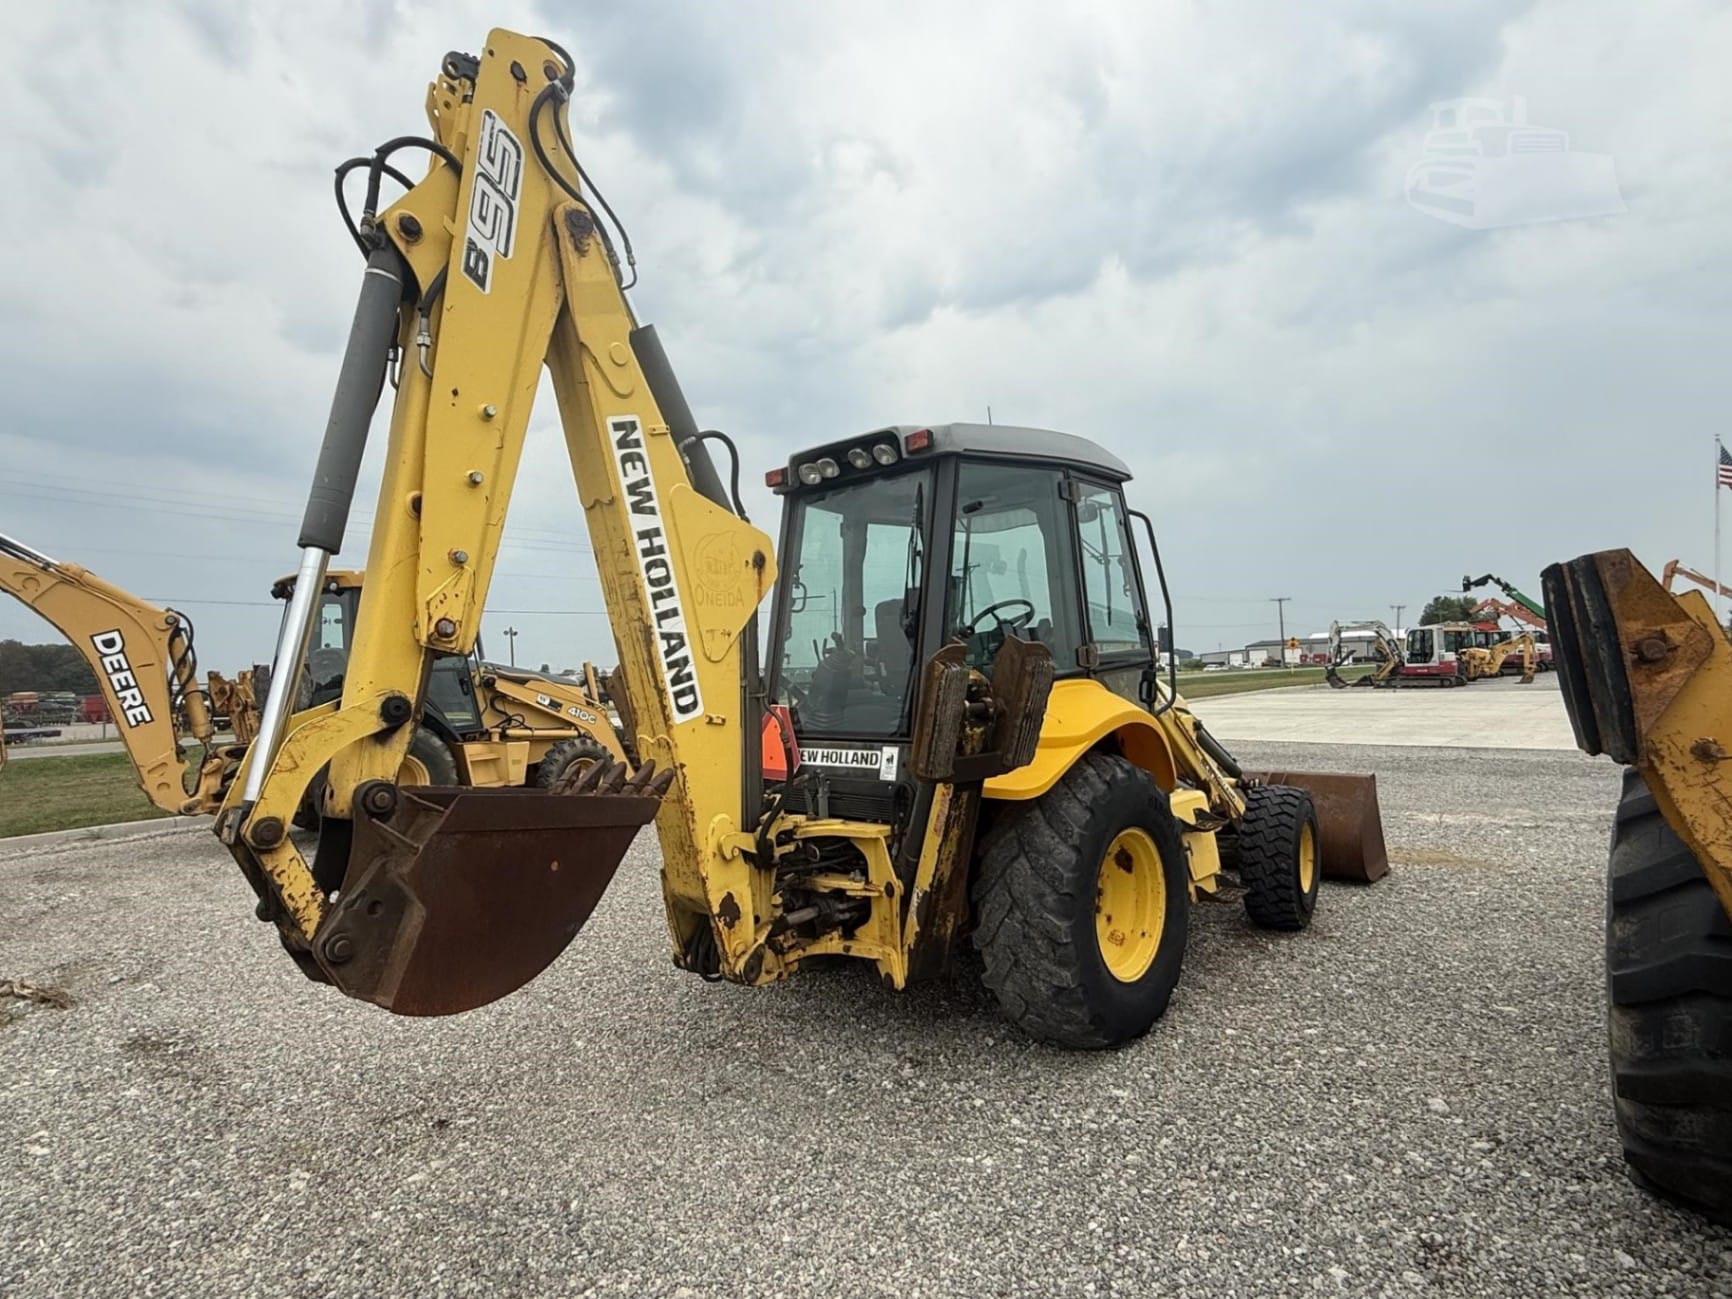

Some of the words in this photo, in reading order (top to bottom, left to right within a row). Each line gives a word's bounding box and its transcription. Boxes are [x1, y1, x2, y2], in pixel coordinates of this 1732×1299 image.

[611, 420, 657, 516] NEW
[637, 527, 699, 715] HOLLAND
[90, 629, 154, 728] DEERE
[800, 750, 819, 762] EW
[821, 751, 879, 766] HOLLAND
